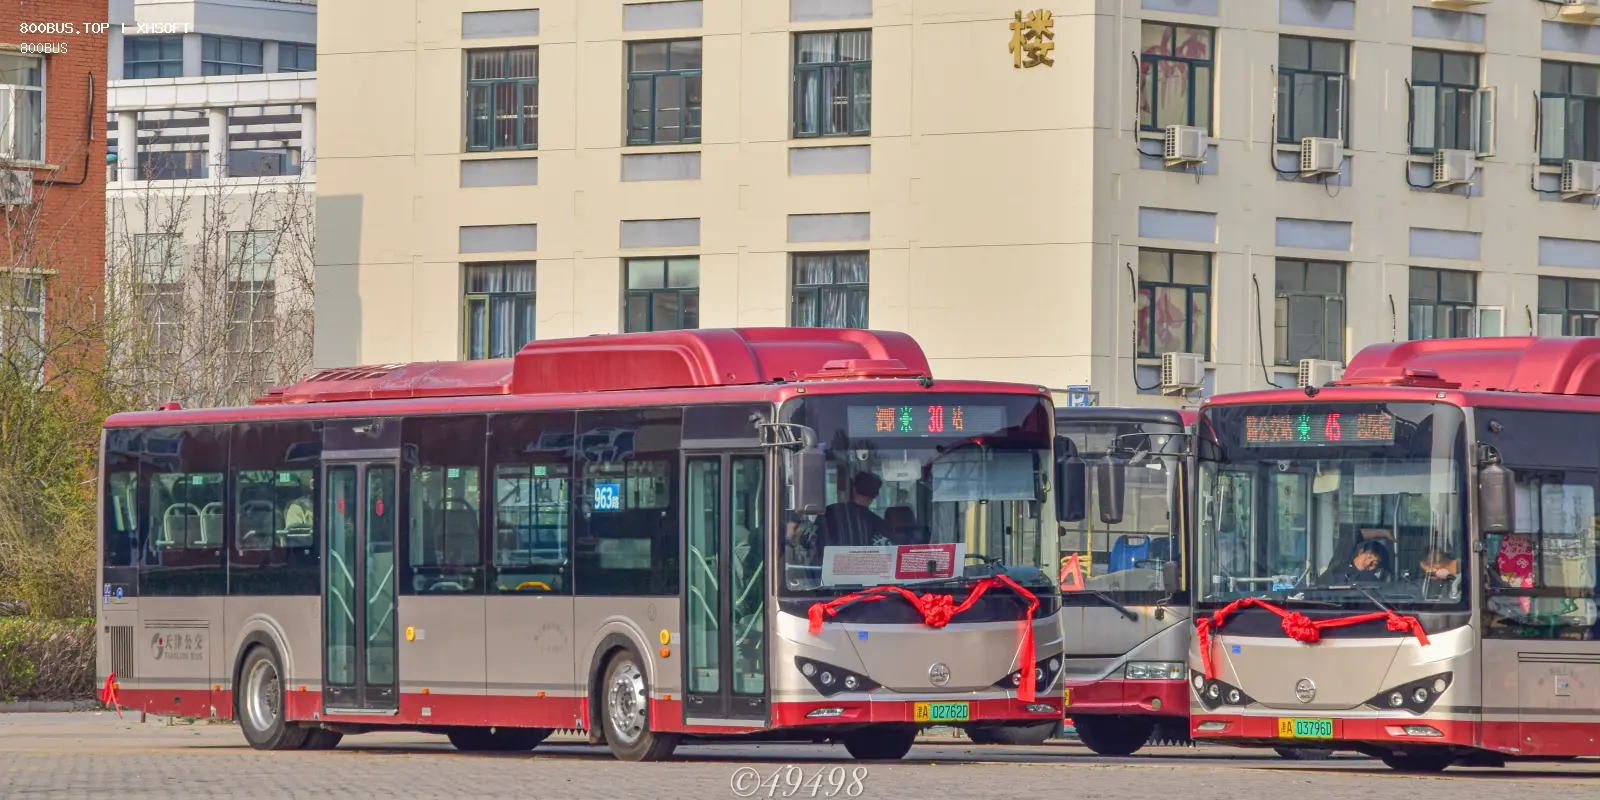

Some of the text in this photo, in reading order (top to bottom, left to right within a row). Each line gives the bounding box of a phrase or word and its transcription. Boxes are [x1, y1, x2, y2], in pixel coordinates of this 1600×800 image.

[1008, 8, 1055, 69] 楼
[927, 404, 943, 432] 30
[164, 633, 203, 650] 天津公交
